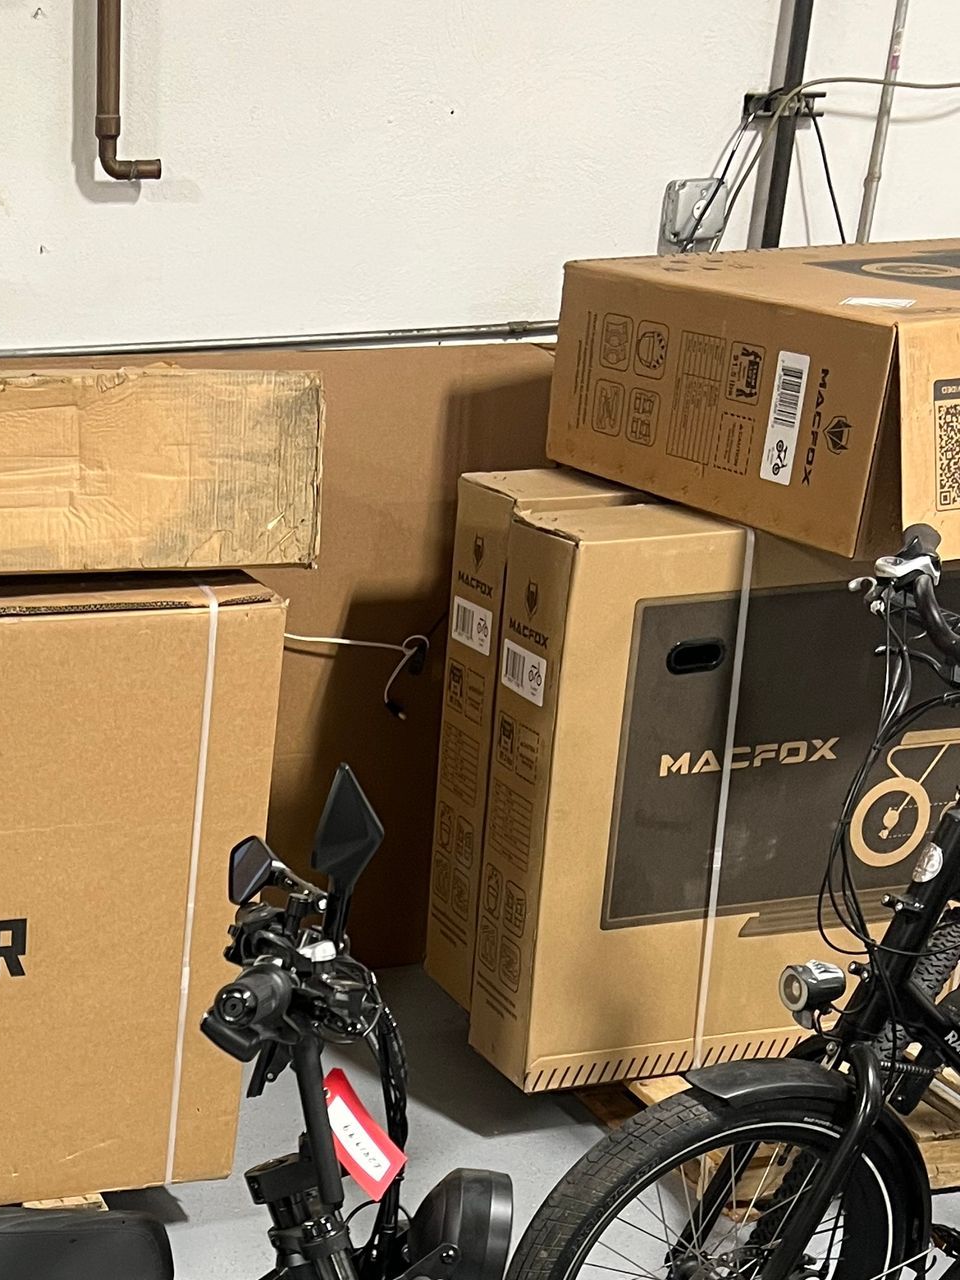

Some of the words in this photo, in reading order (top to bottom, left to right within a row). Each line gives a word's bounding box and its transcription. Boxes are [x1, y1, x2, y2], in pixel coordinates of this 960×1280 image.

[801, 368, 830, 486] MACFOX
[458, 570, 494, 599] MACFOX
[509, 616, 550, 649] MACFOX
[659, 737, 840, 777] MACFOX
